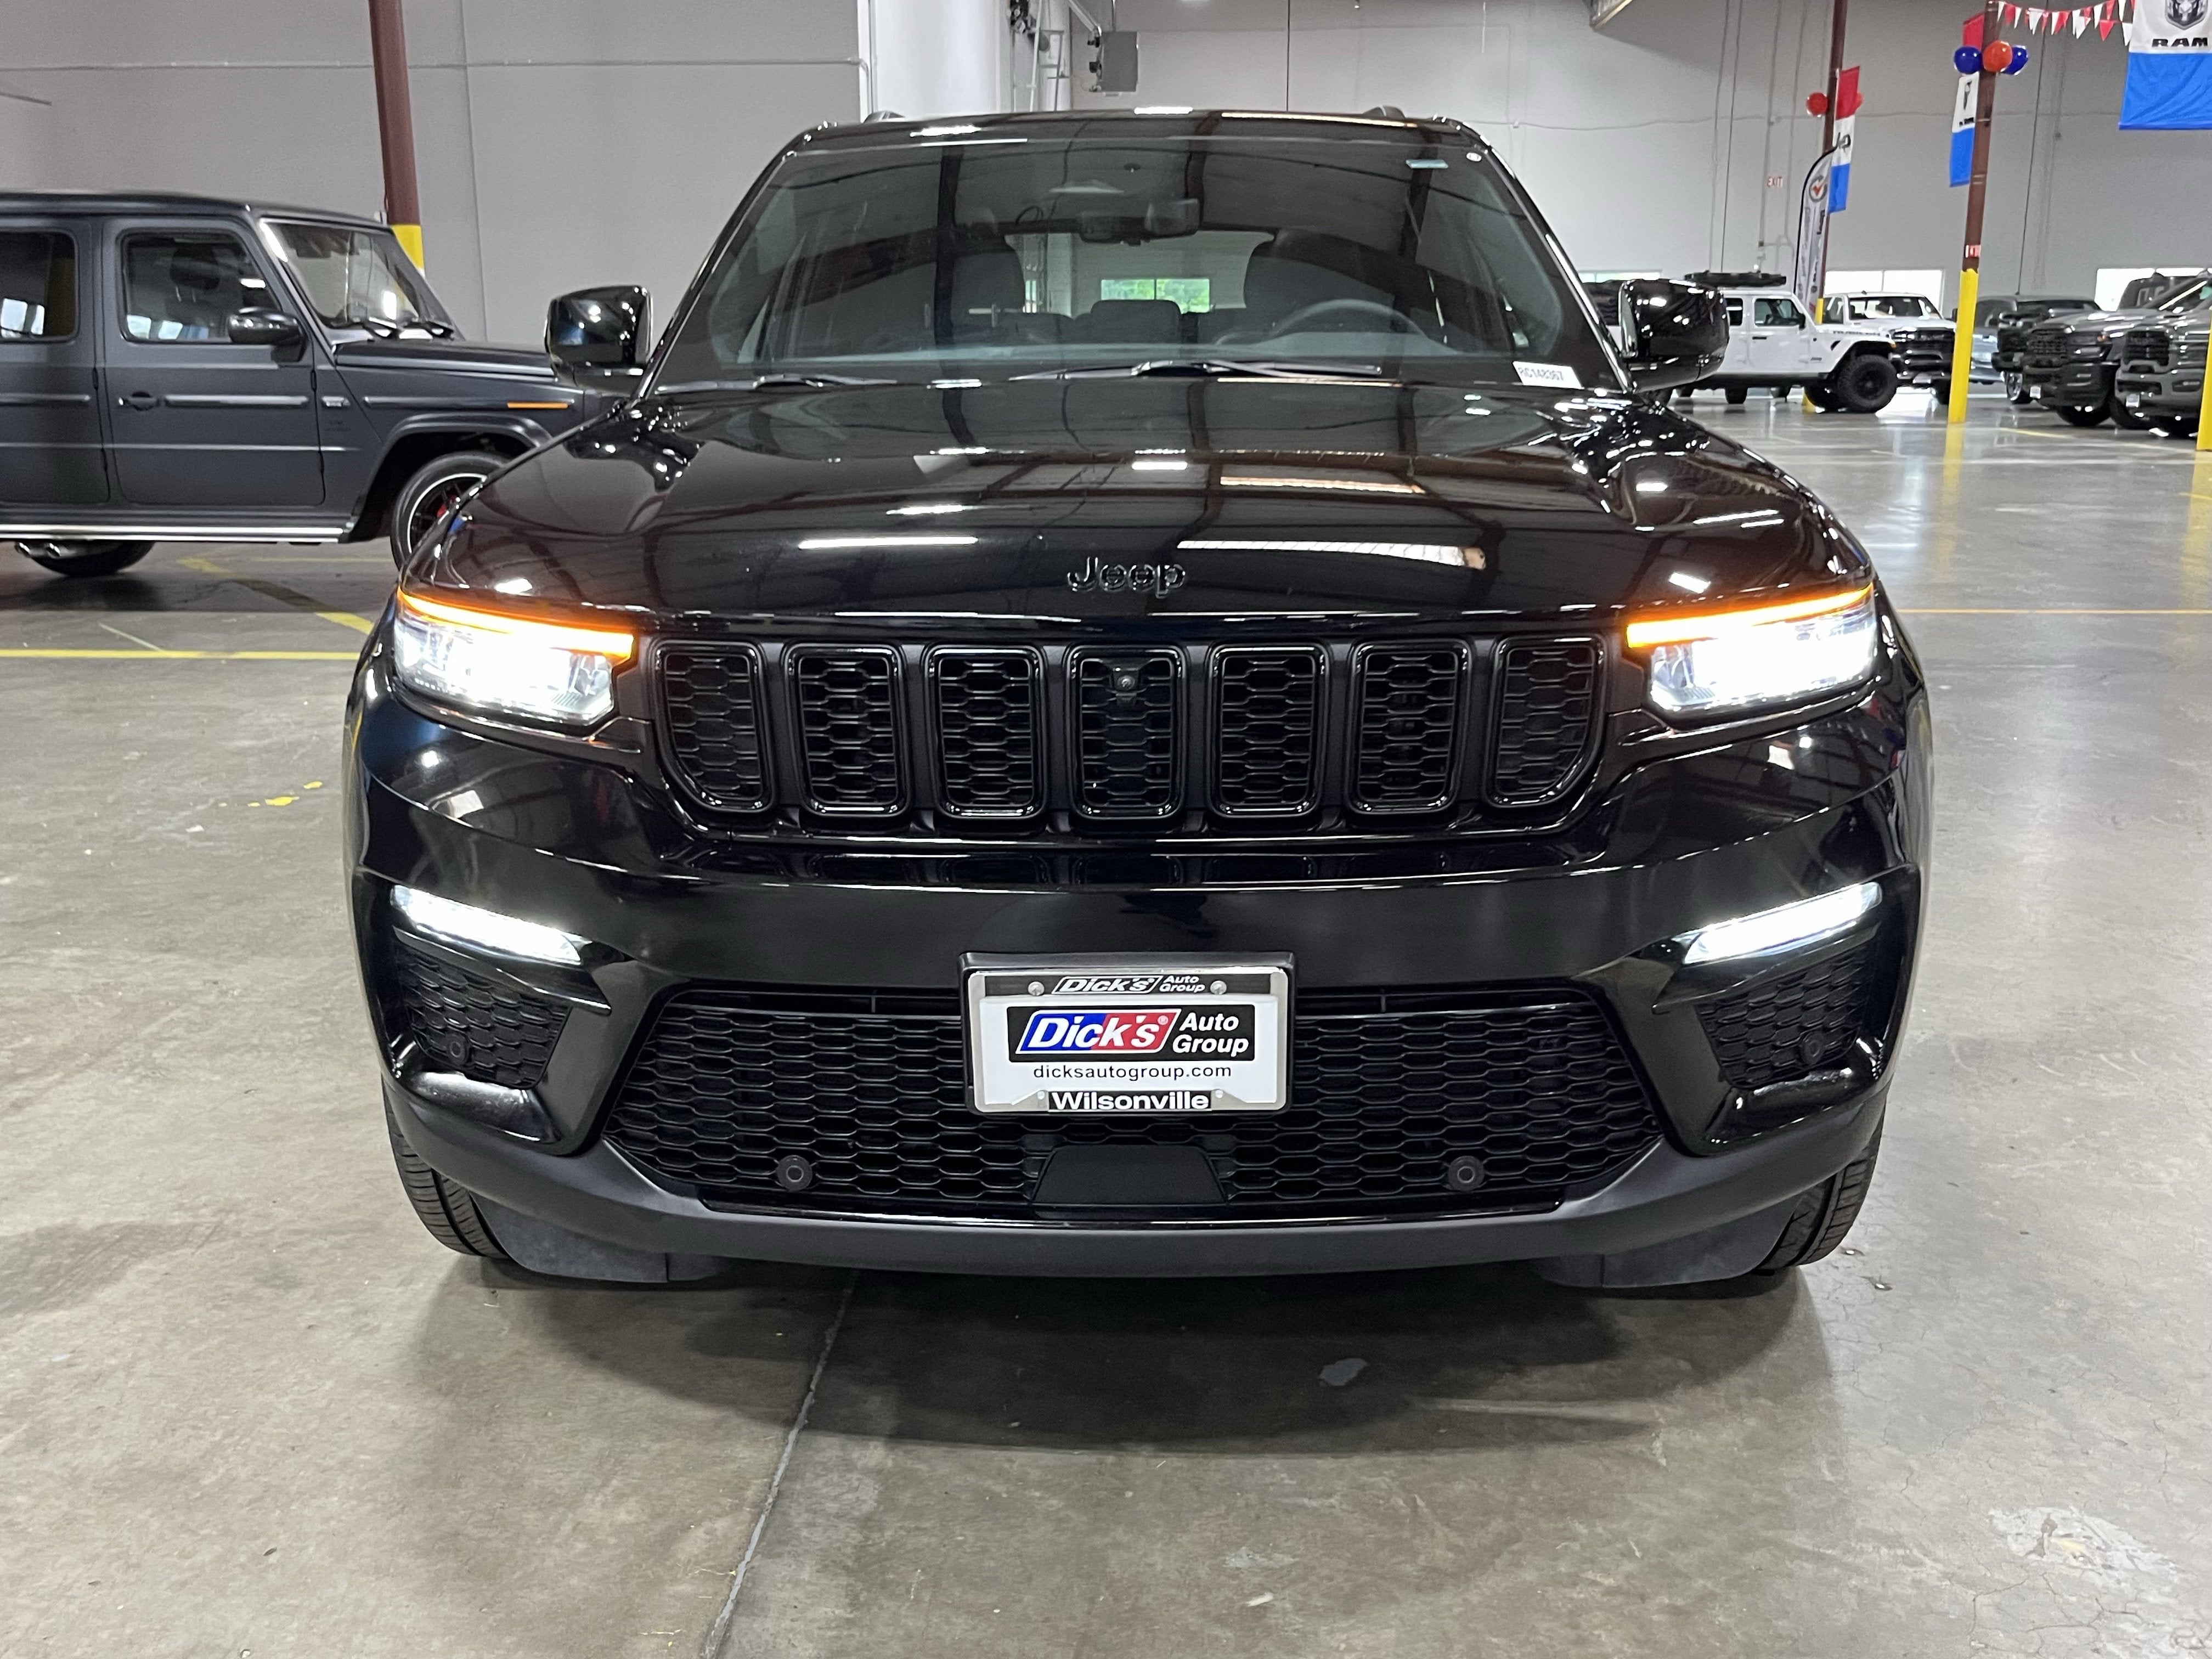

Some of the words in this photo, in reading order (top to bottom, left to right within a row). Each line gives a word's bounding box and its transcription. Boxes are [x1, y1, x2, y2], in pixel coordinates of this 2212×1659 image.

[2153, 37, 2208, 47] RAM
[1767, 176, 1783, 188] EXIT
[1067, 557, 1185, 598] Jeep
[1060, 977, 1151, 992] Dick's
[1164, 975, 1199, 984] Auto
[1159, 983, 1205, 994] Group
[1028, 1015, 1160, 1048] Dick's
[1180, 1012, 1239, 1031] Auto
[1172, 1034, 1249, 1058] Group
[1033, 1065, 1232, 1081] dicksautogroup.com
[1051, 1091, 1209, 1110] Wilsonville
